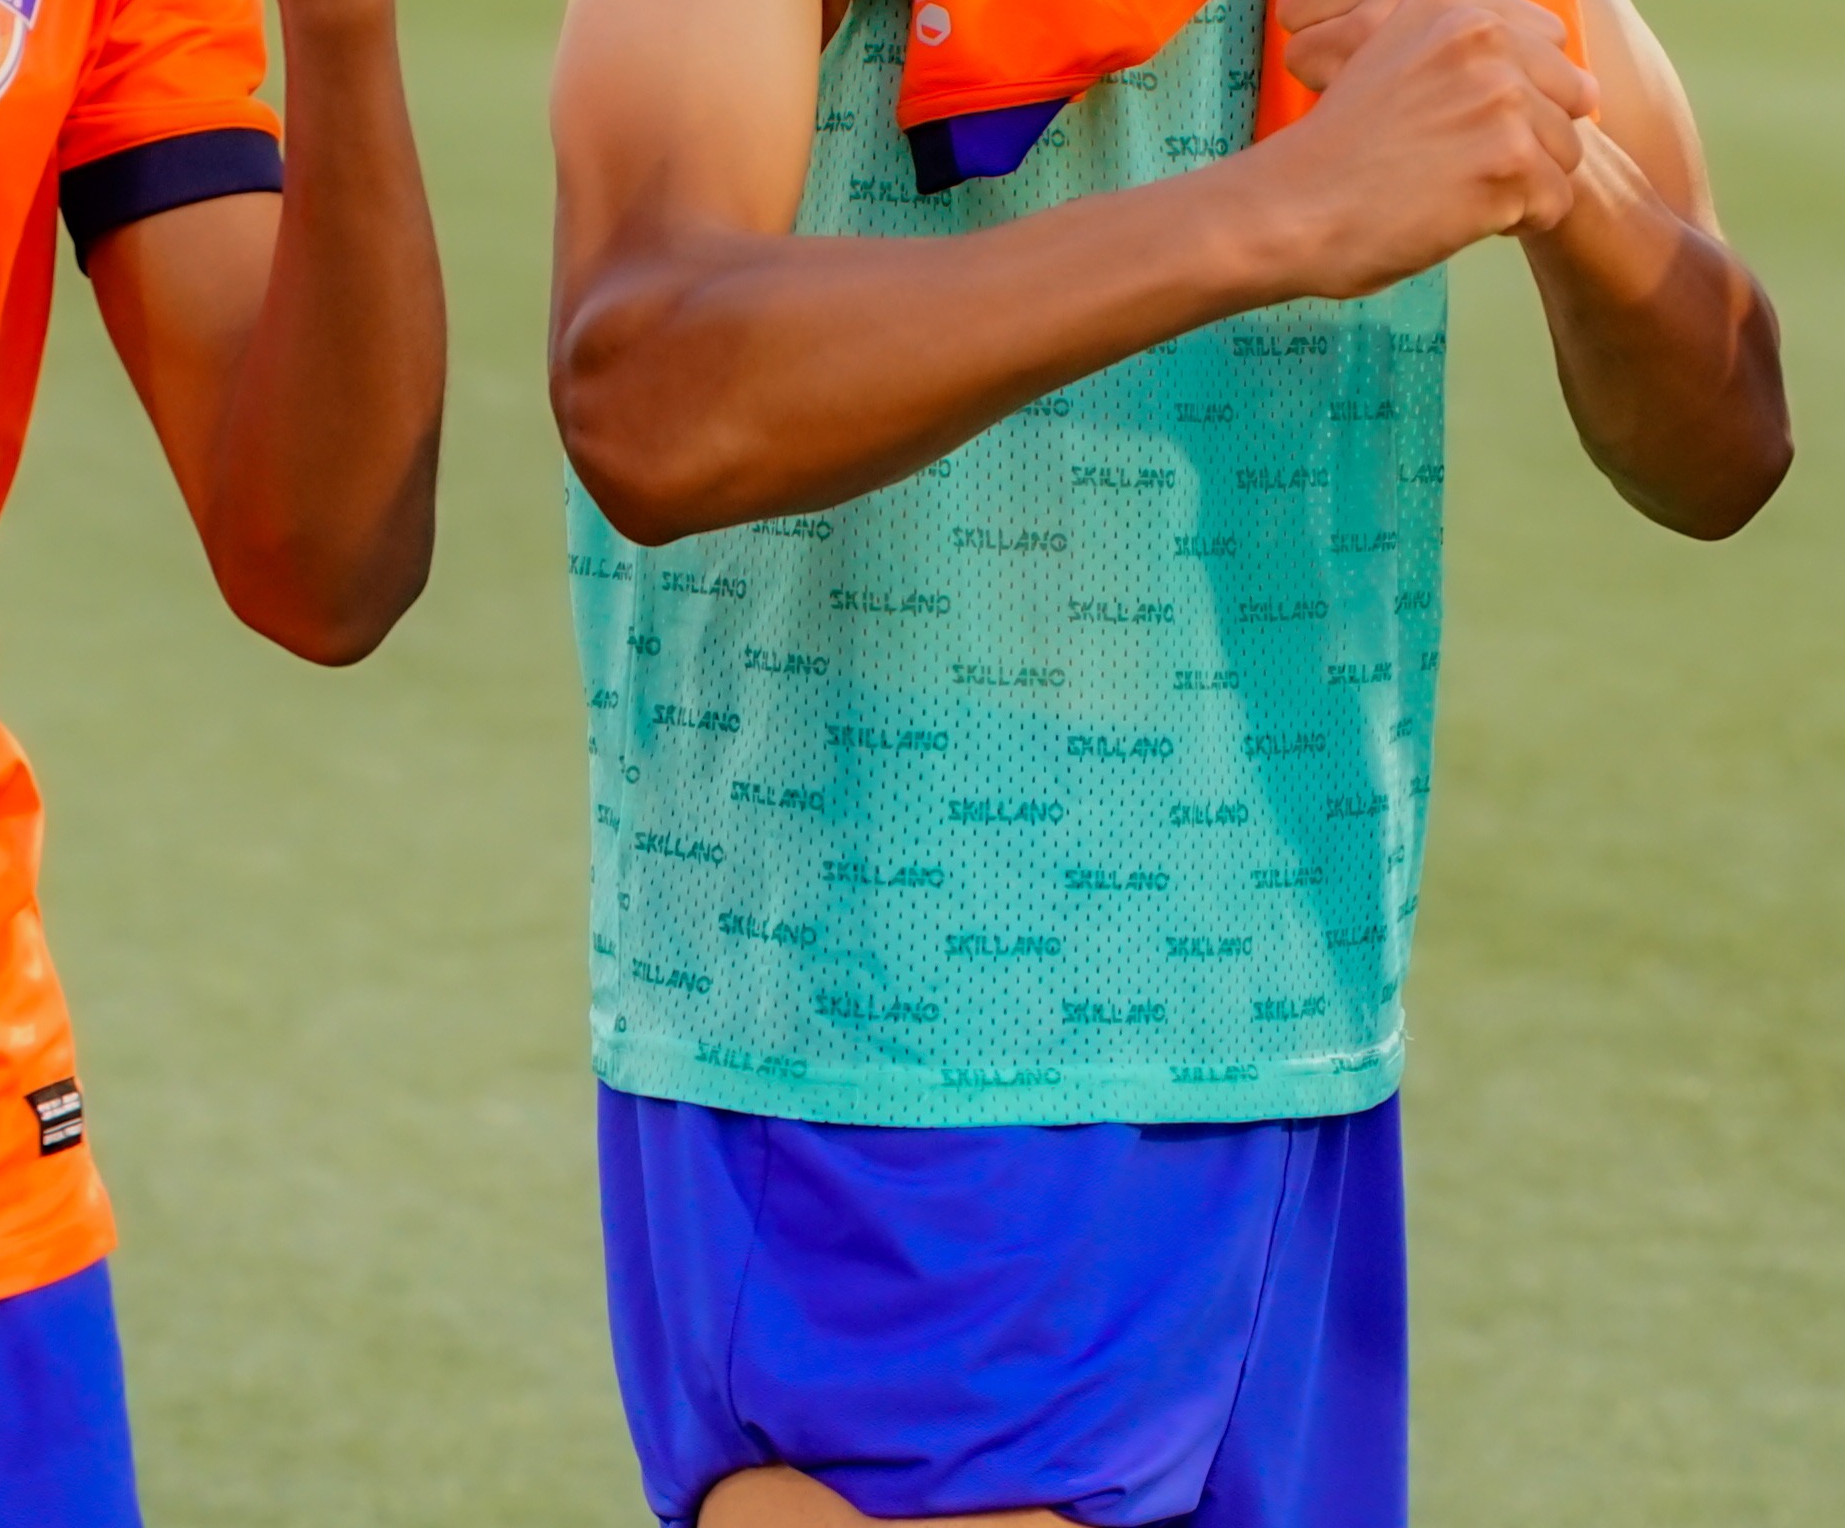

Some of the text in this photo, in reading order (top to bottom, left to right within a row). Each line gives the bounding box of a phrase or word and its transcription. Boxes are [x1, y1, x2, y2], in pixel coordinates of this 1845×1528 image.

[1232, 336, 1328, 356] SKILLANO
[1070, 466, 1176, 489] SKILLANO
[1236, 468, 1332, 490] SKILLANO
[951, 527, 1069, 553] SKILLANO
[660, 571, 747, 599] SKILLANO
[829, 589, 952, 614] SKILLANO
[1068, 599, 1175, 623] SKILLANO
[1238, 600, 1330, 622] SKILLANO
[744, 645, 830, 676] SKILLANO
[951, 663, 1066, 688] SKILLANO
[1172, 670, 1240, 691] SKILLANO
[651, 704, 741, 734] SKILLANO
[825, 725, 949, 752] SKILLANO
[1067, 735, 1174, 759] SKILLANO
[1242, 733, 1327, 757] SKILLANO
[729, 780, 825, 812] SKILLANO
[947, 799, 1064, 823] SKILLANO
[1169, 803, 1249, 826] SKILLANO
[634, 831, 727, 866] SKILLANO
[822, 860, 946, 888] SKILLANO
[1064, 868, 1170, 891] SKILLANO
[718, 911, 817, 946] SKILLANO
[943, 934, 1062, 957] SKILLANO
[1165, 936, 1253, 958] SKILLANO
[814, 994, 940, 1023] SKILLANO
[1061, 1001, 1166, 1024] SKILLANO
[695, 1042, 808, 1079] SKILLANO
[941, 1067, 1062, 1089] SKILLANO
